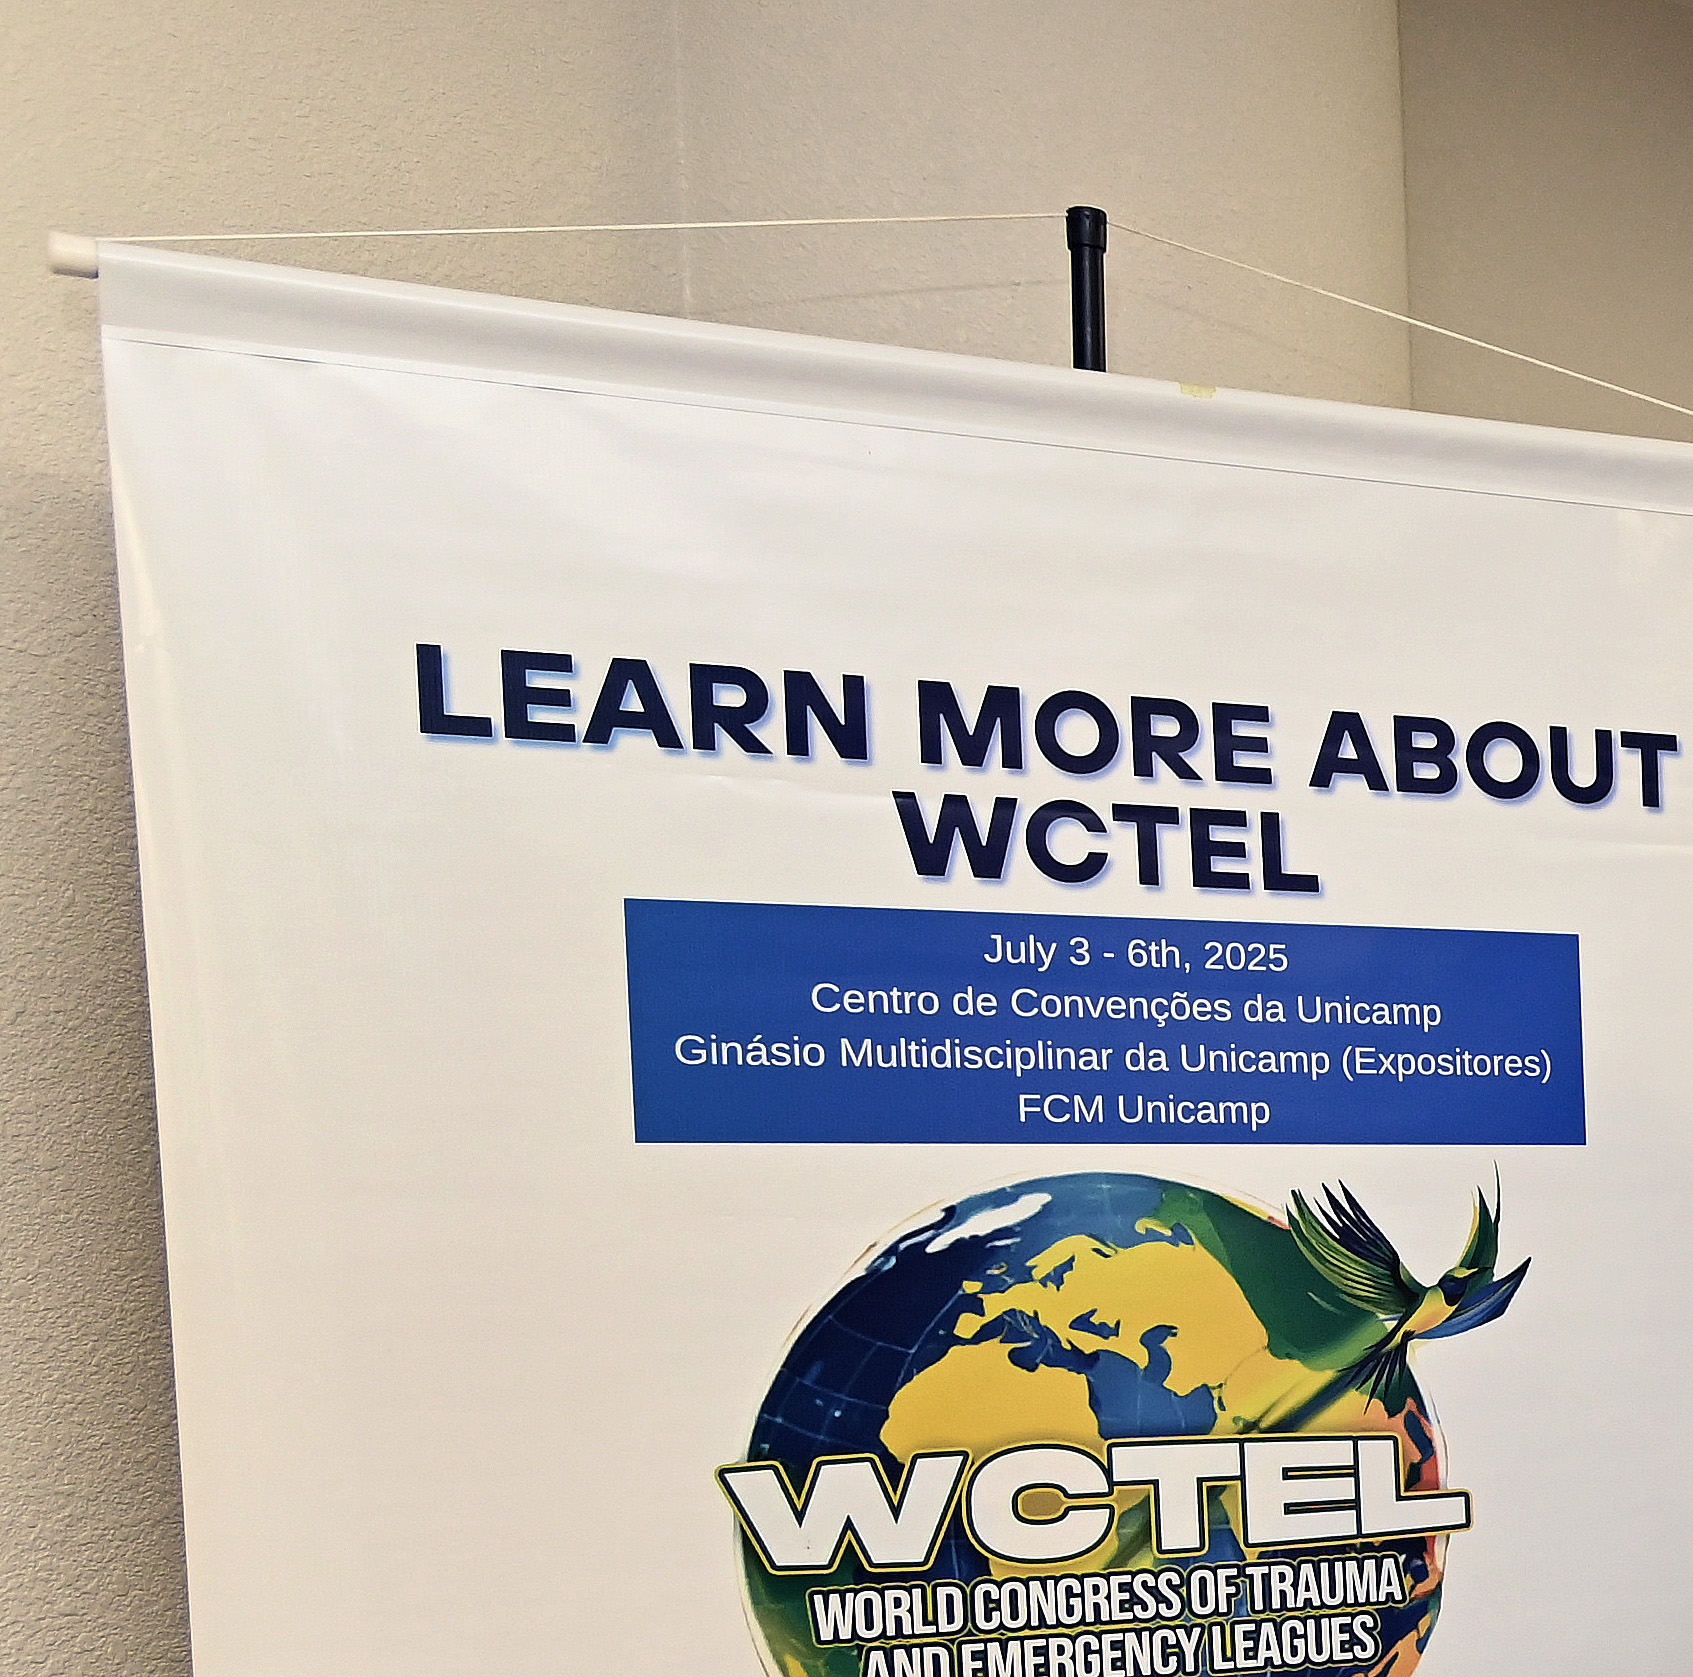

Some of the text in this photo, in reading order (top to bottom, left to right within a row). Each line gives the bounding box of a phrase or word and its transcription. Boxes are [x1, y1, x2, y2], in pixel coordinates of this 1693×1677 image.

[415, 643, 1678, 808] LEARN MORE ABOUT
[891, 790, 1320, 893] WCTEL
[983, 934, 1057, 972] July
[1069, 936, 1091, 966] 3
[1127, 938, 1191, 974] 6th,
[1204, 941, 1288, 972] 2025
[811, 982, 1441, 1033] Centro de Convenções da Unicamp
[674, 1034, 1551, 1084] Ginásio Multidisciplinar da Unicamp (Expositores)
[1019, 1094, 1270, 1132] FCM Unicamp
[722, 1438, 1472, 1568] WCTEL
[812, 1557, 1404, 1642] WORLD CONGRESS OF TRAUMA
[1213, 1616, 1381, 1668] LEAGUES
